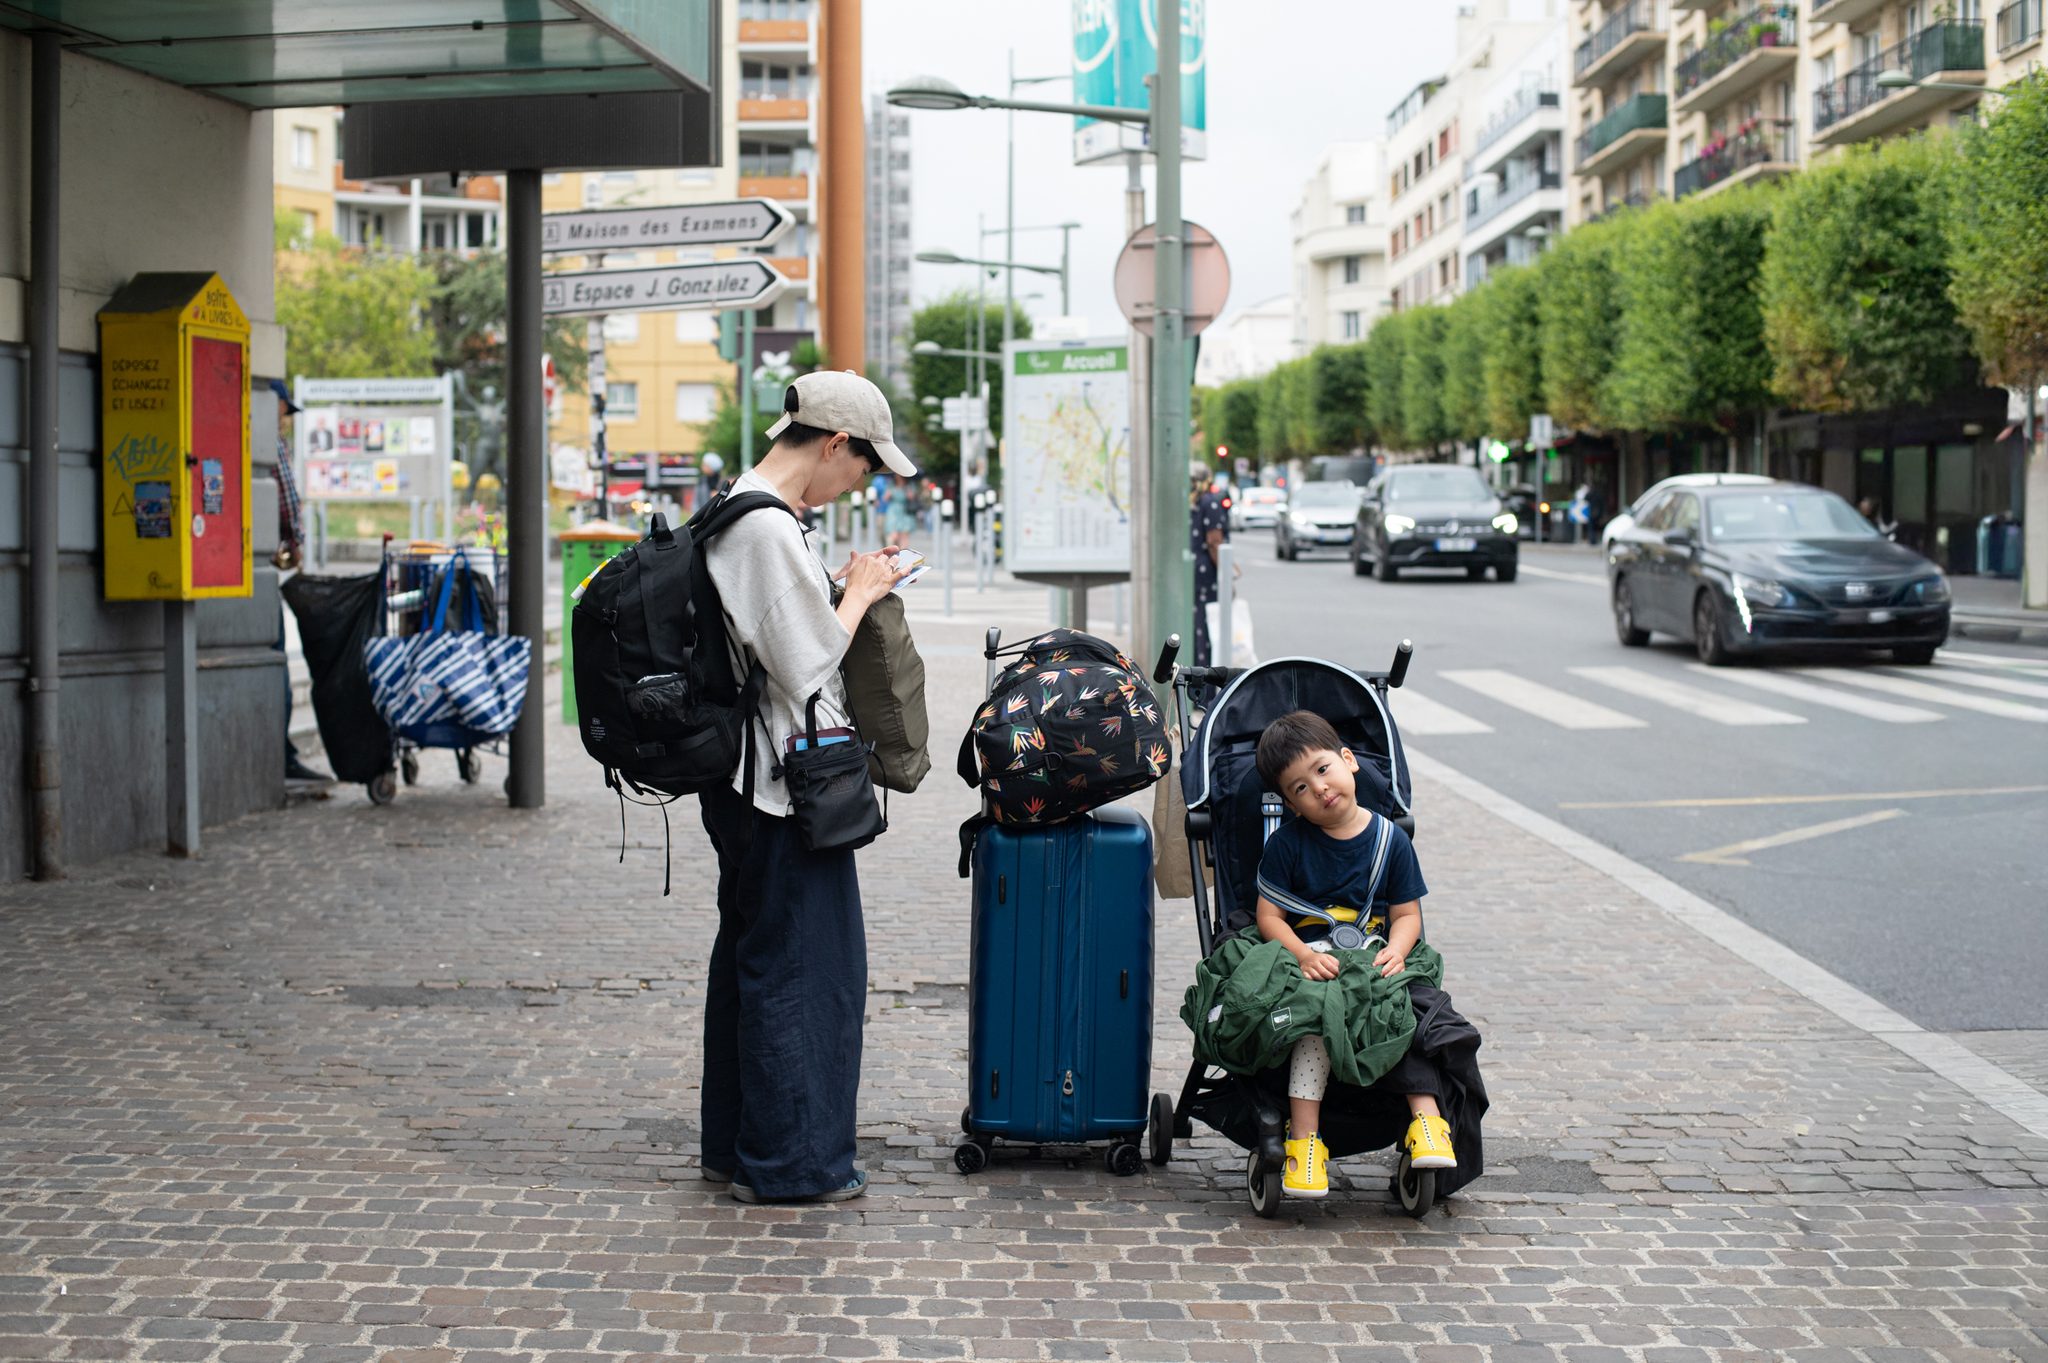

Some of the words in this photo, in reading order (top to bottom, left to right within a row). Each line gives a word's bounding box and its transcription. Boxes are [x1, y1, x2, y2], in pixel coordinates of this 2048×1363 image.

[568, 223, 629, 240] Maison
[640, 220, 669, 235] des
[681, 214, 757, 233] Examens
[573, 282, 634, 304] Espace
[646, 280, 660, 298] J.
[112, 358, 160, 372] DÉPOSEZ
[112, 377, 170, 391] ÉCHANGEZ
